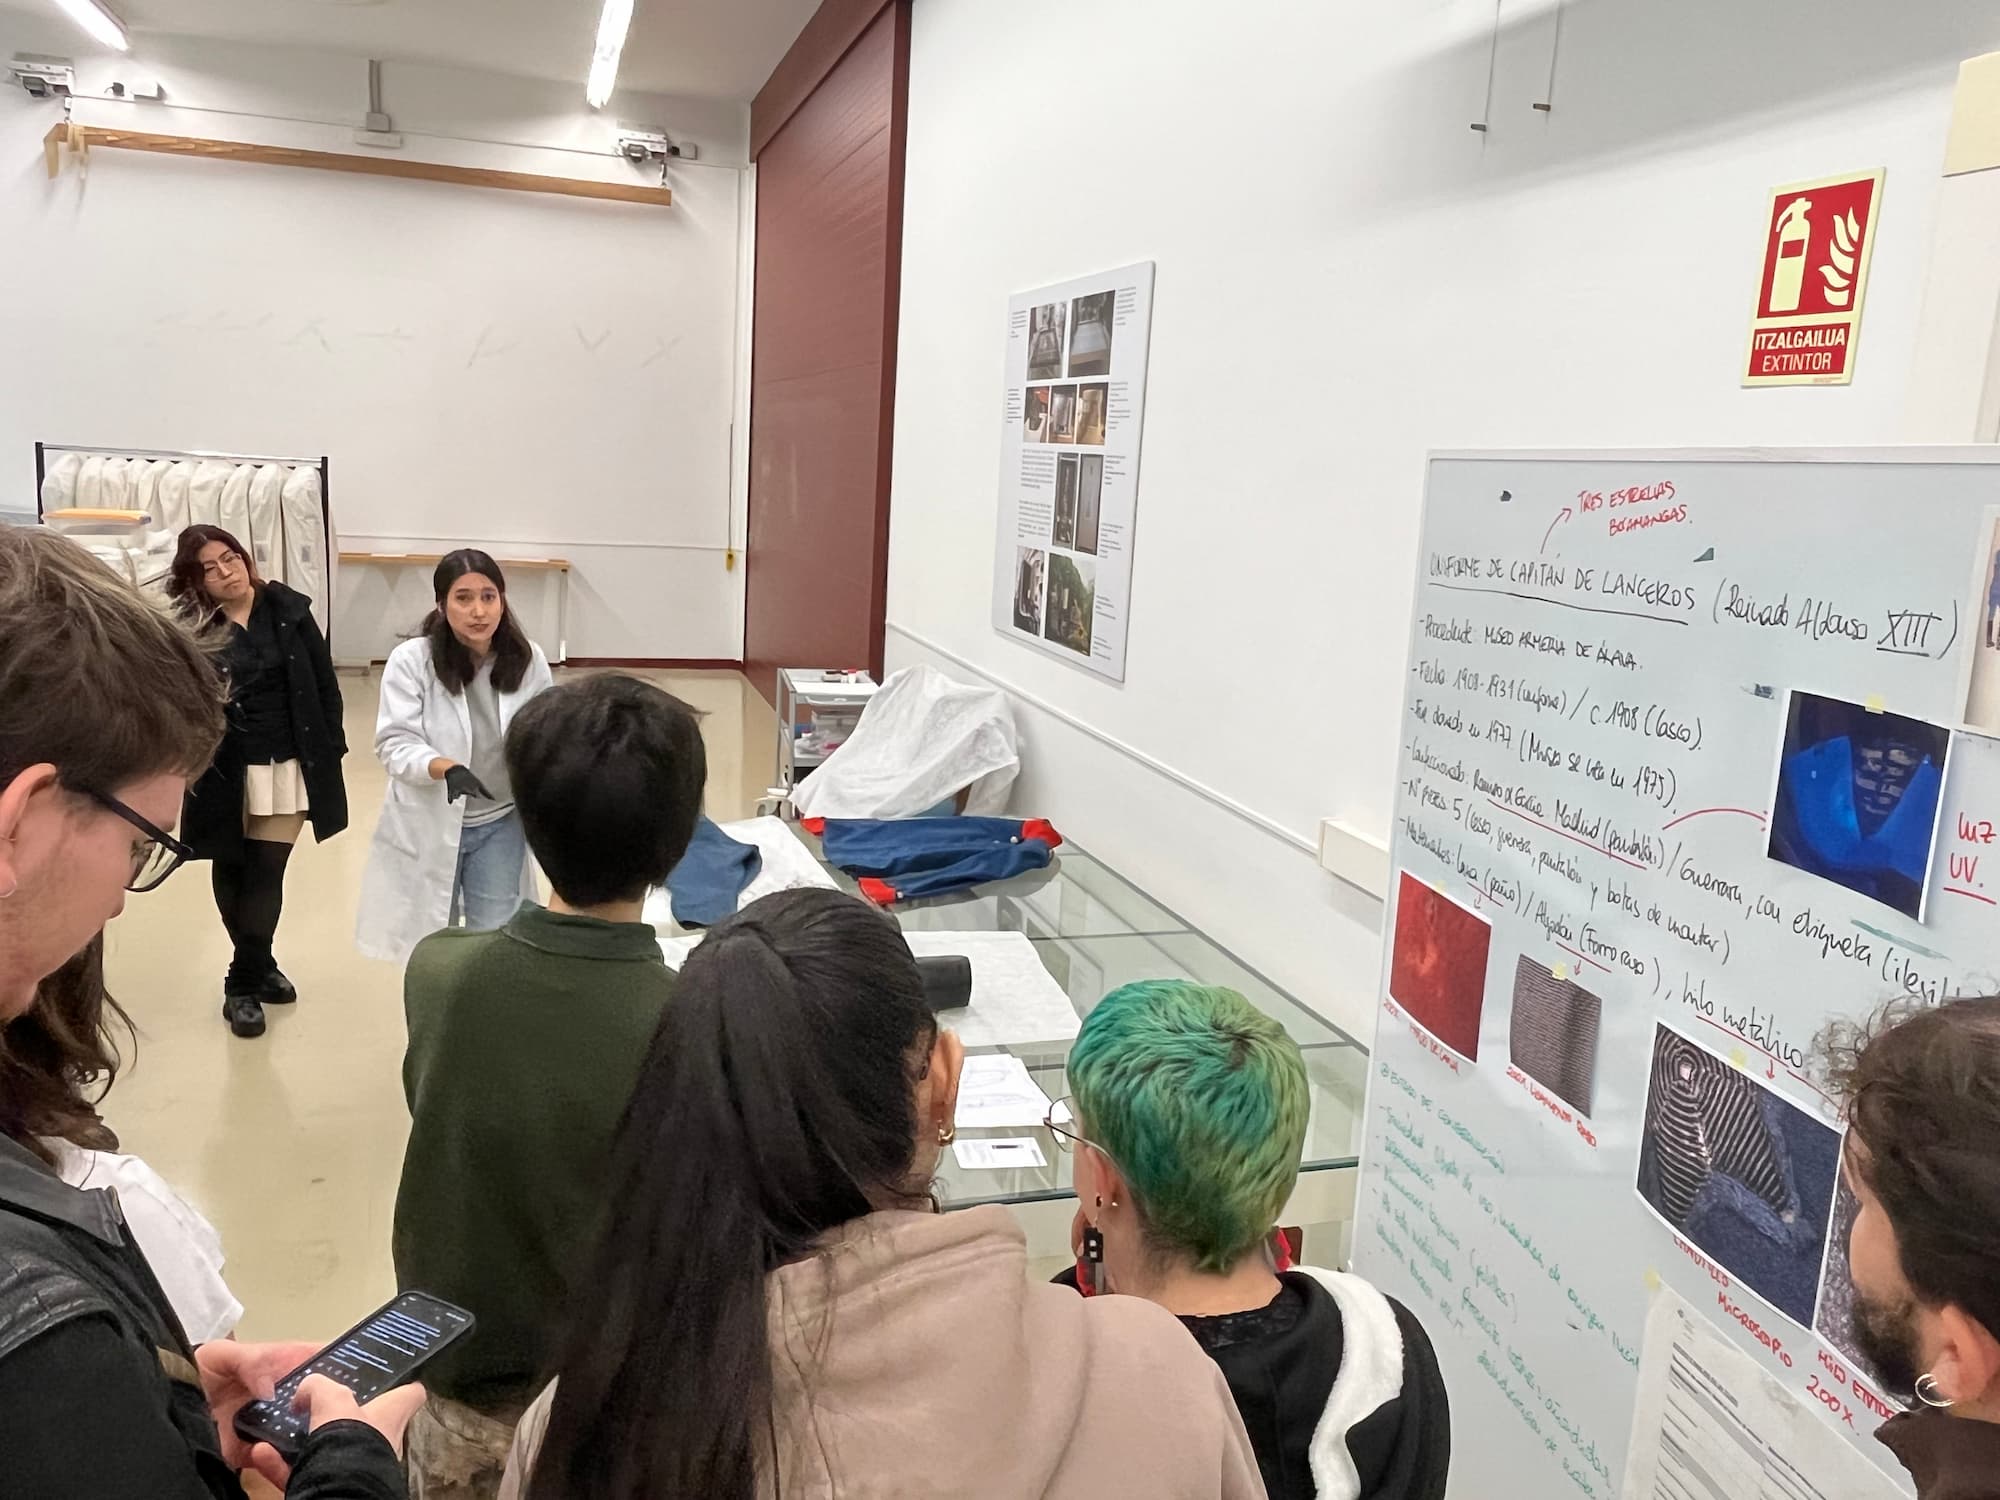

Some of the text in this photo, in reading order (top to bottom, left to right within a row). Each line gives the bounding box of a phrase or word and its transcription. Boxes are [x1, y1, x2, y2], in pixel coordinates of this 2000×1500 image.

[1755, 328, 1845, 350] ITZALGAILUA
[1762, 353, 1832, 372] EXTINTOR
[1487, 556, 1505, 579] DE
[1575, 568, 1595, 592] DE
[1602, 571, 1696, 611] LANCEROS
[1576, 641, 1593, 658] DE
[1606, 702, 1639, 731] 1908
[1607, 877, 1641, 918] botas
[1793, 907, 1872, 967] etiqueta
[1723, 1006, 1803, 1069] metálico
